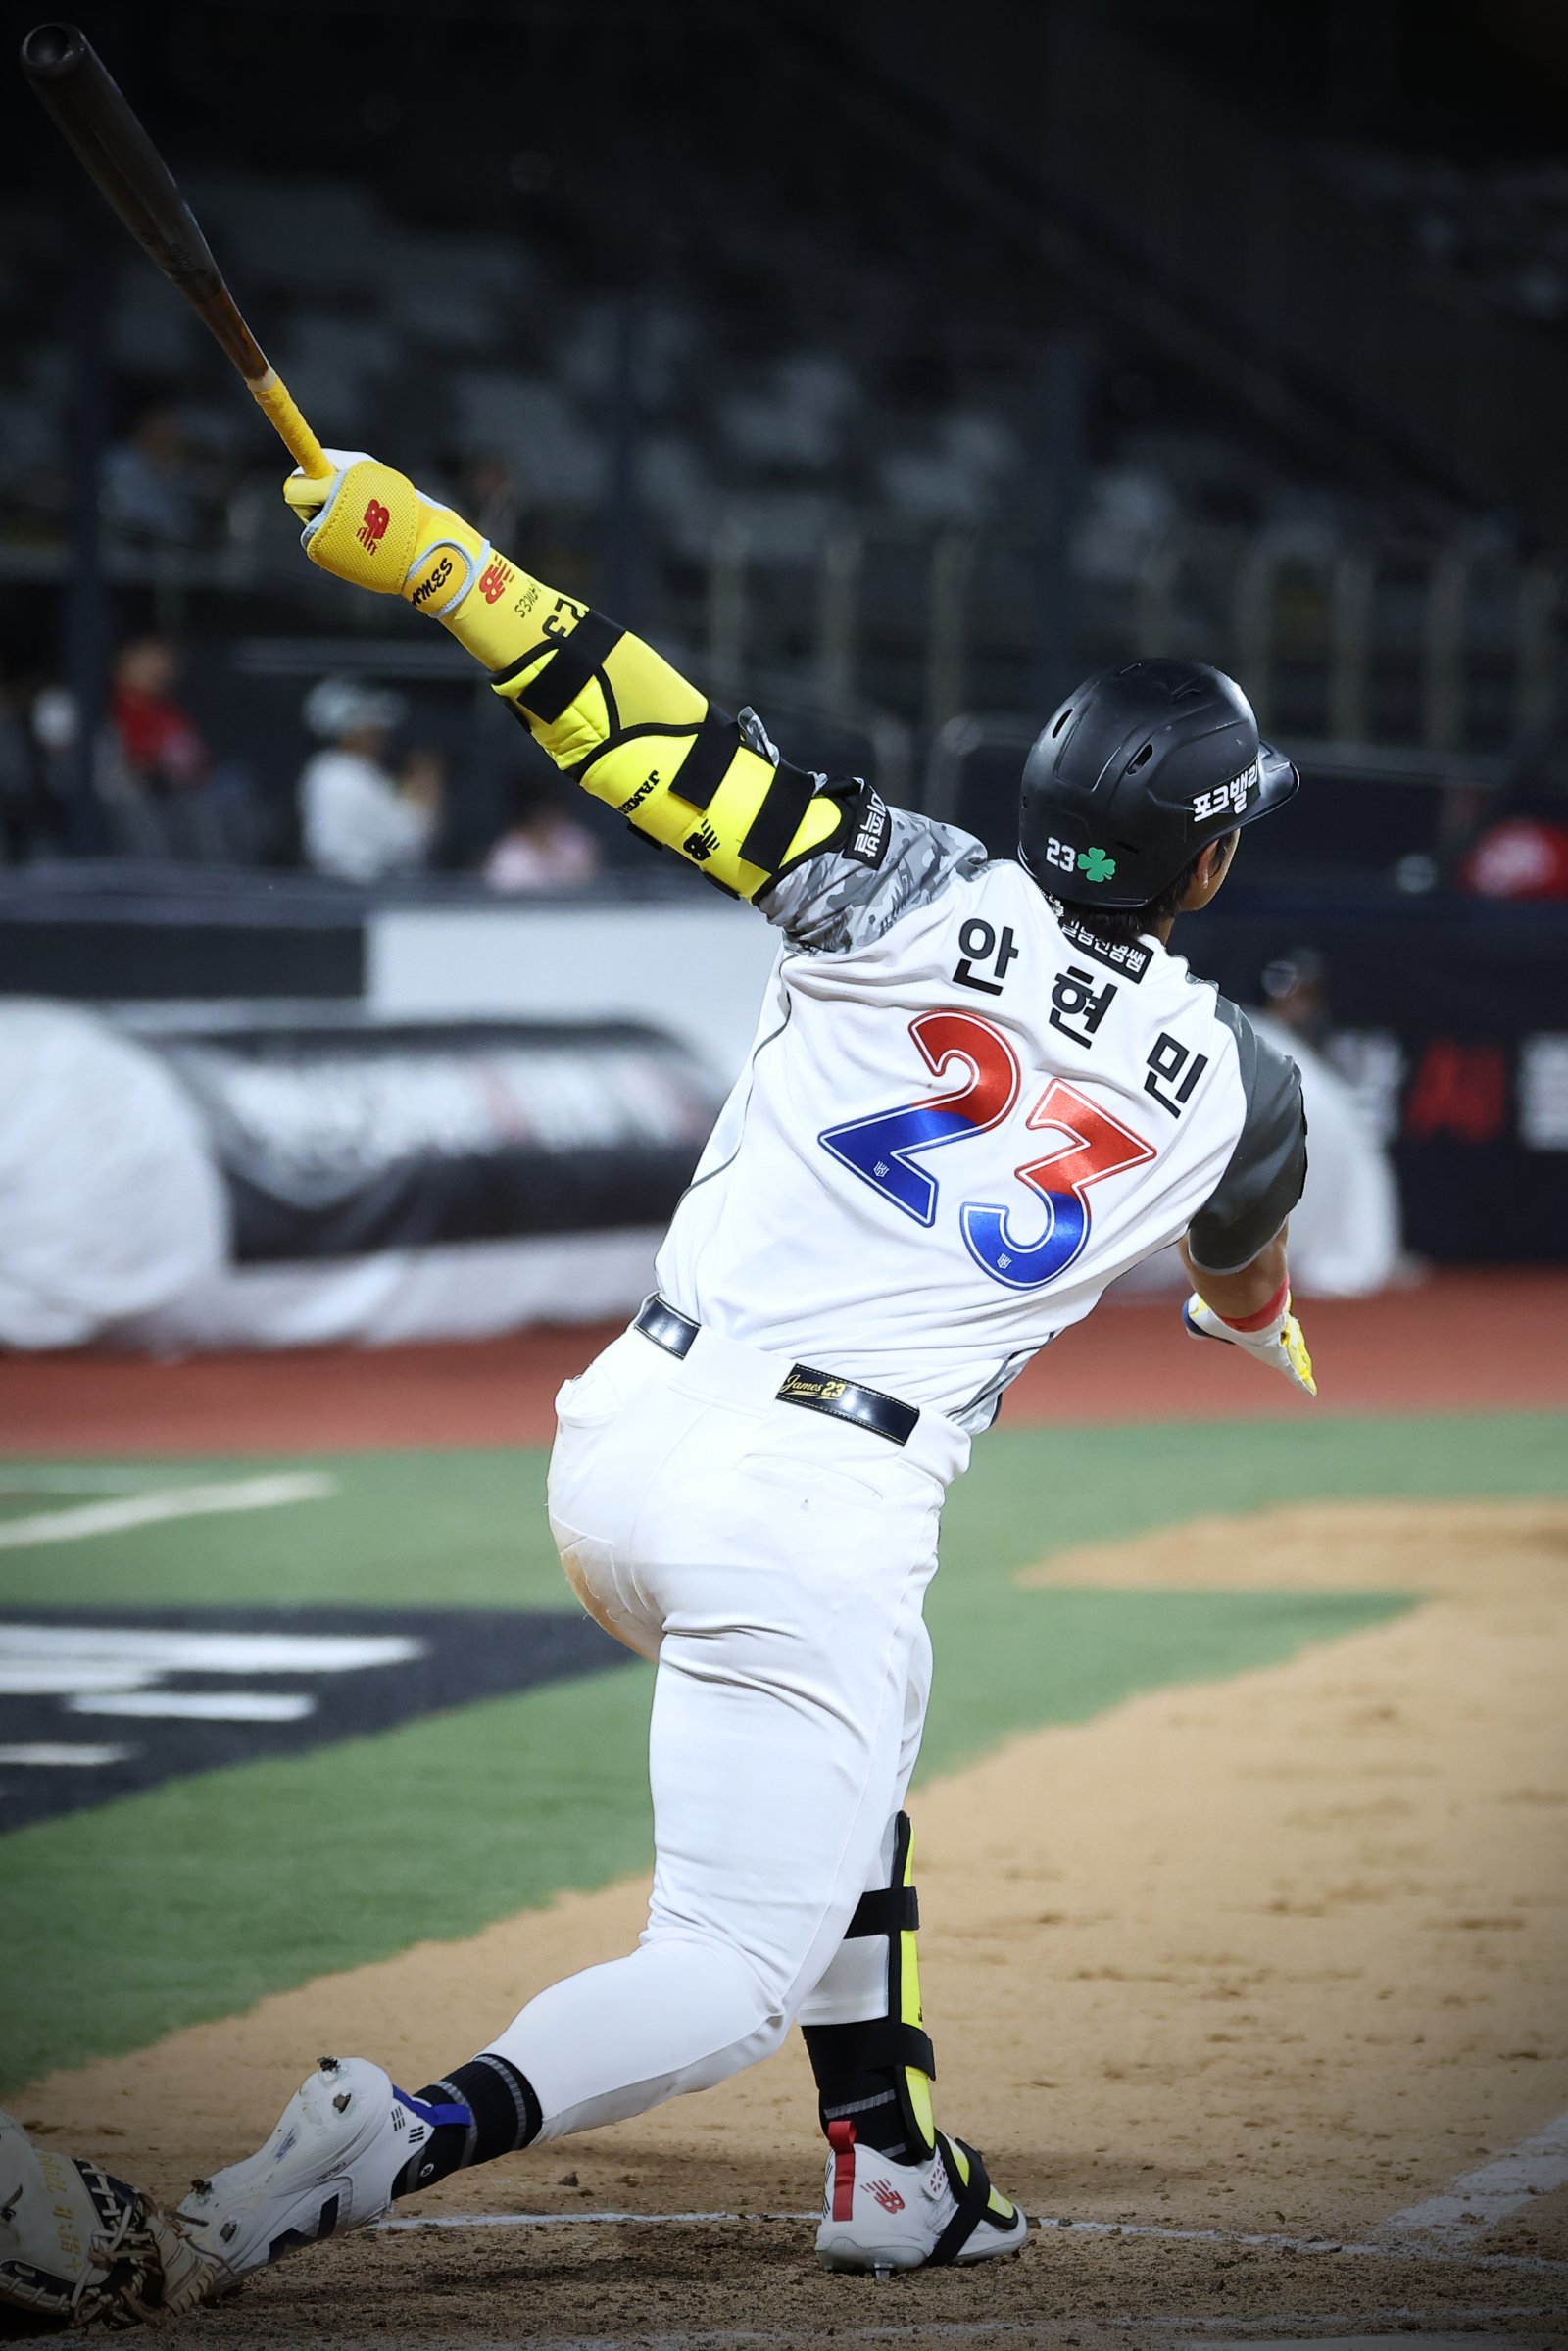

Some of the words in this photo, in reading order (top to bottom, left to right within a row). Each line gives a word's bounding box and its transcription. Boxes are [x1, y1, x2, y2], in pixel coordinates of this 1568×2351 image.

[412, 557, 453, 608] AMES
[1193, 759, 1258, 822] 포크밸리
[1046, 837, 1075, 873] 23
[818, 1008, 1157, 1291] 23
[779, 1374, 824, 1393] James
[821, 1381, 846, 1398] 23
